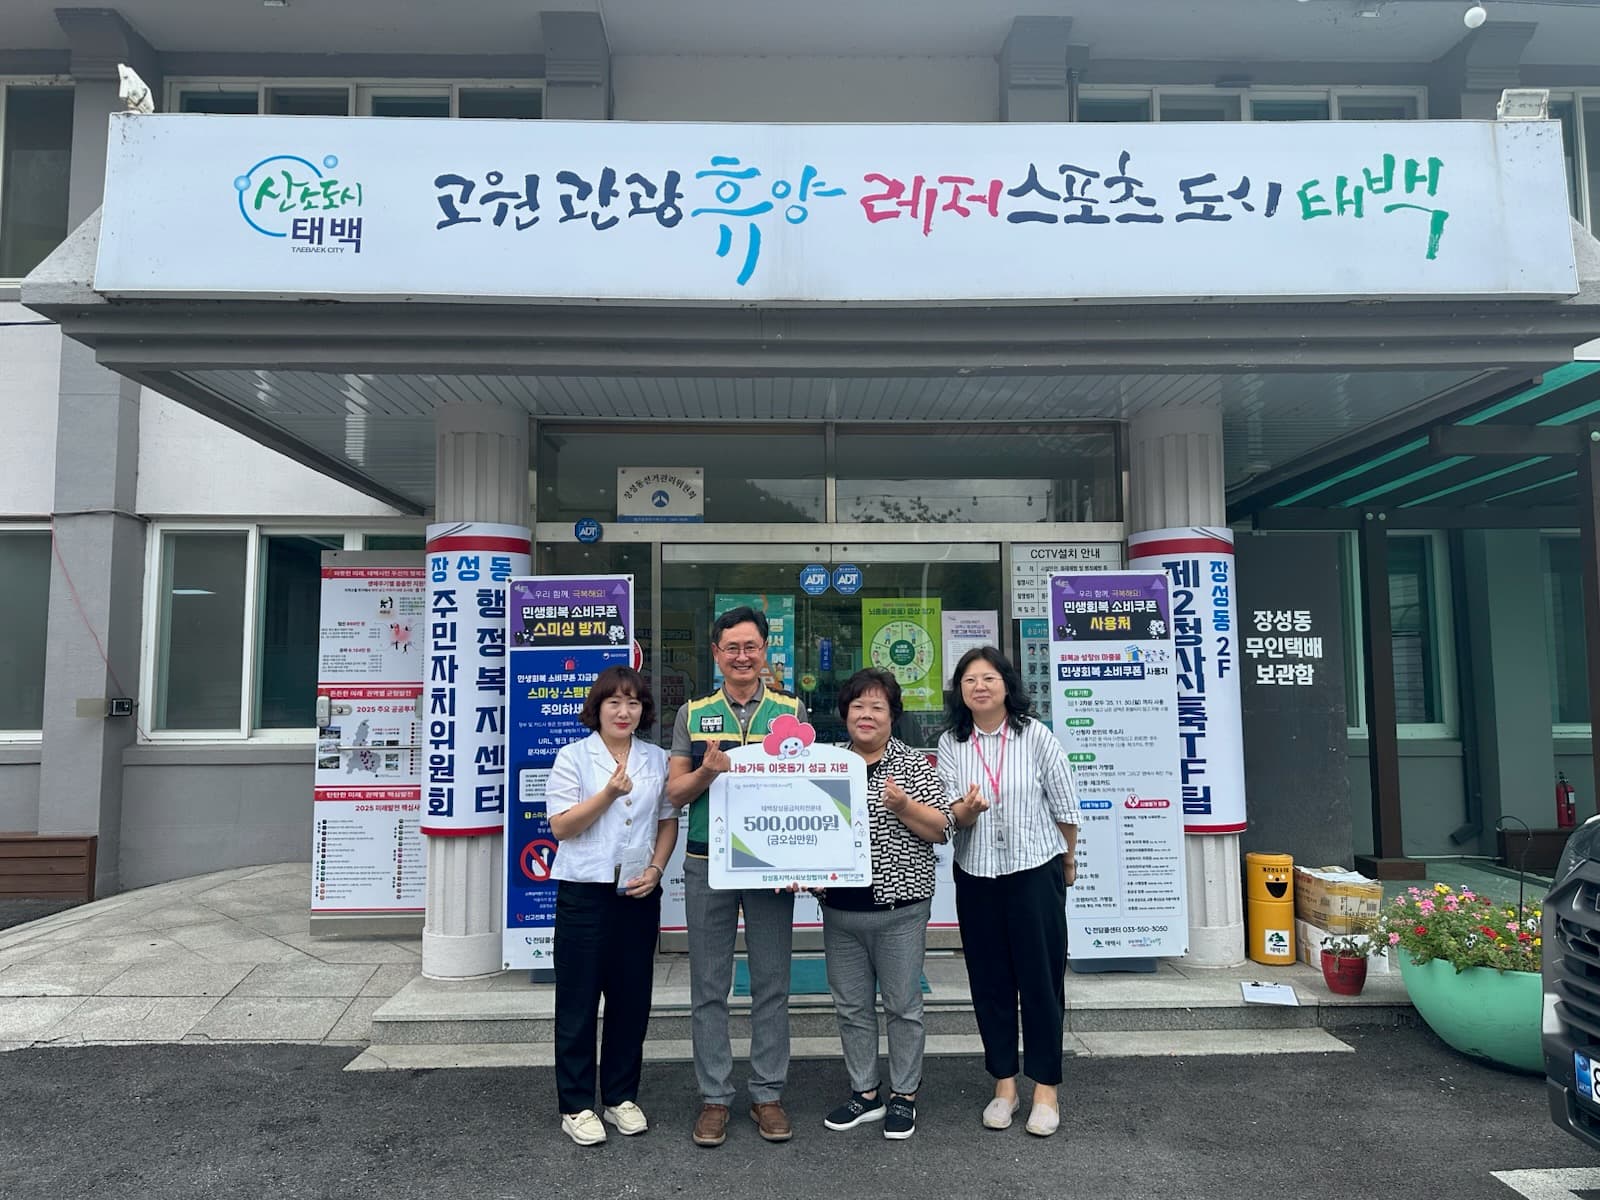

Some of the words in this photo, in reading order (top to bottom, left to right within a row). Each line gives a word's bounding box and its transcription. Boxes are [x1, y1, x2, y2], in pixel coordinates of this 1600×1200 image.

[254, 170, 363, 213] 산소도시
[434, 170, 540, 231] 고원
[556, 166, 683, 231] 관광
[692, 156, 847, 286] 휴양
[860, 172, 1003, 237] 레저
[1006, 151, 1163, 223] 스포츠
[1174, 172, 1282, 222] 도시
[1295, 153, 1448, 259] 태백
[292, 217, 363, 253] 태백
[291, 246, 325, 254] TAEBAEK
[326, 246, 345, 254] CITY
[579, 526, 598, 537] ADT
[1030, 548, 1077, 560] CCTV설치
[1080, 547, 1100, 560] 안내
[431, 556, 512, 583] 장성동
[804, 573, 826, 585] ADT
[837, 573, 859, 585] ADT
[535, 590, 551, 599] 우리
[553, 590, 570, 599] 함께,
[1079, 589, 1093, 598] 우리
[1209, 561, 1230, 632] 장성동
[522, 606, 570, 620] 민생회복
[571, 604, 618, 619] 소비쿠폰
[1063, 600, 1109, 614] 민생회복
[1112, 600, 1158, 613] 소비쿠폰
[1090, 616, 1132, 631] 사용처
[1253, 609, 1312, 632] 장성동
[533, 621, 576, 637] 스미싱
[579, 620, 607, 636] 방지
[1245, 636, 1323, 658] 무인택배
[1216, 636, 1231, 679] 2F
[517, 674, 547, 684] 민생회복
[547, 673, 576, 683] 소비쿠폰
[1061, 666, 1101, 678] 민생회복
[1104, 666, 1143, 677] 소비쿠폰
[1146, 667, 1169, 676] 사용처
[1256, 663, 1315, 686] 보관함
[427, 589, 459, 818] 주민자치위원회
[474, 588, 505, 814] 행정복지센터
[541, 703, 584, 716] 주의하세
[729, 763, 765, 774] 나눔가득
[768, 763, 806, 774] 이웃돕기
[808, 763, 827, 774] 성금
[830, 762, 849, 773] 지원
[743, 814, 840, 833] 500,000원
[767, 834, 818, 846] (금오십만원)
[1092, 926, 1121, 934] 전담콜센터
[1122, 925, 1168, 933] 033-550-3050
